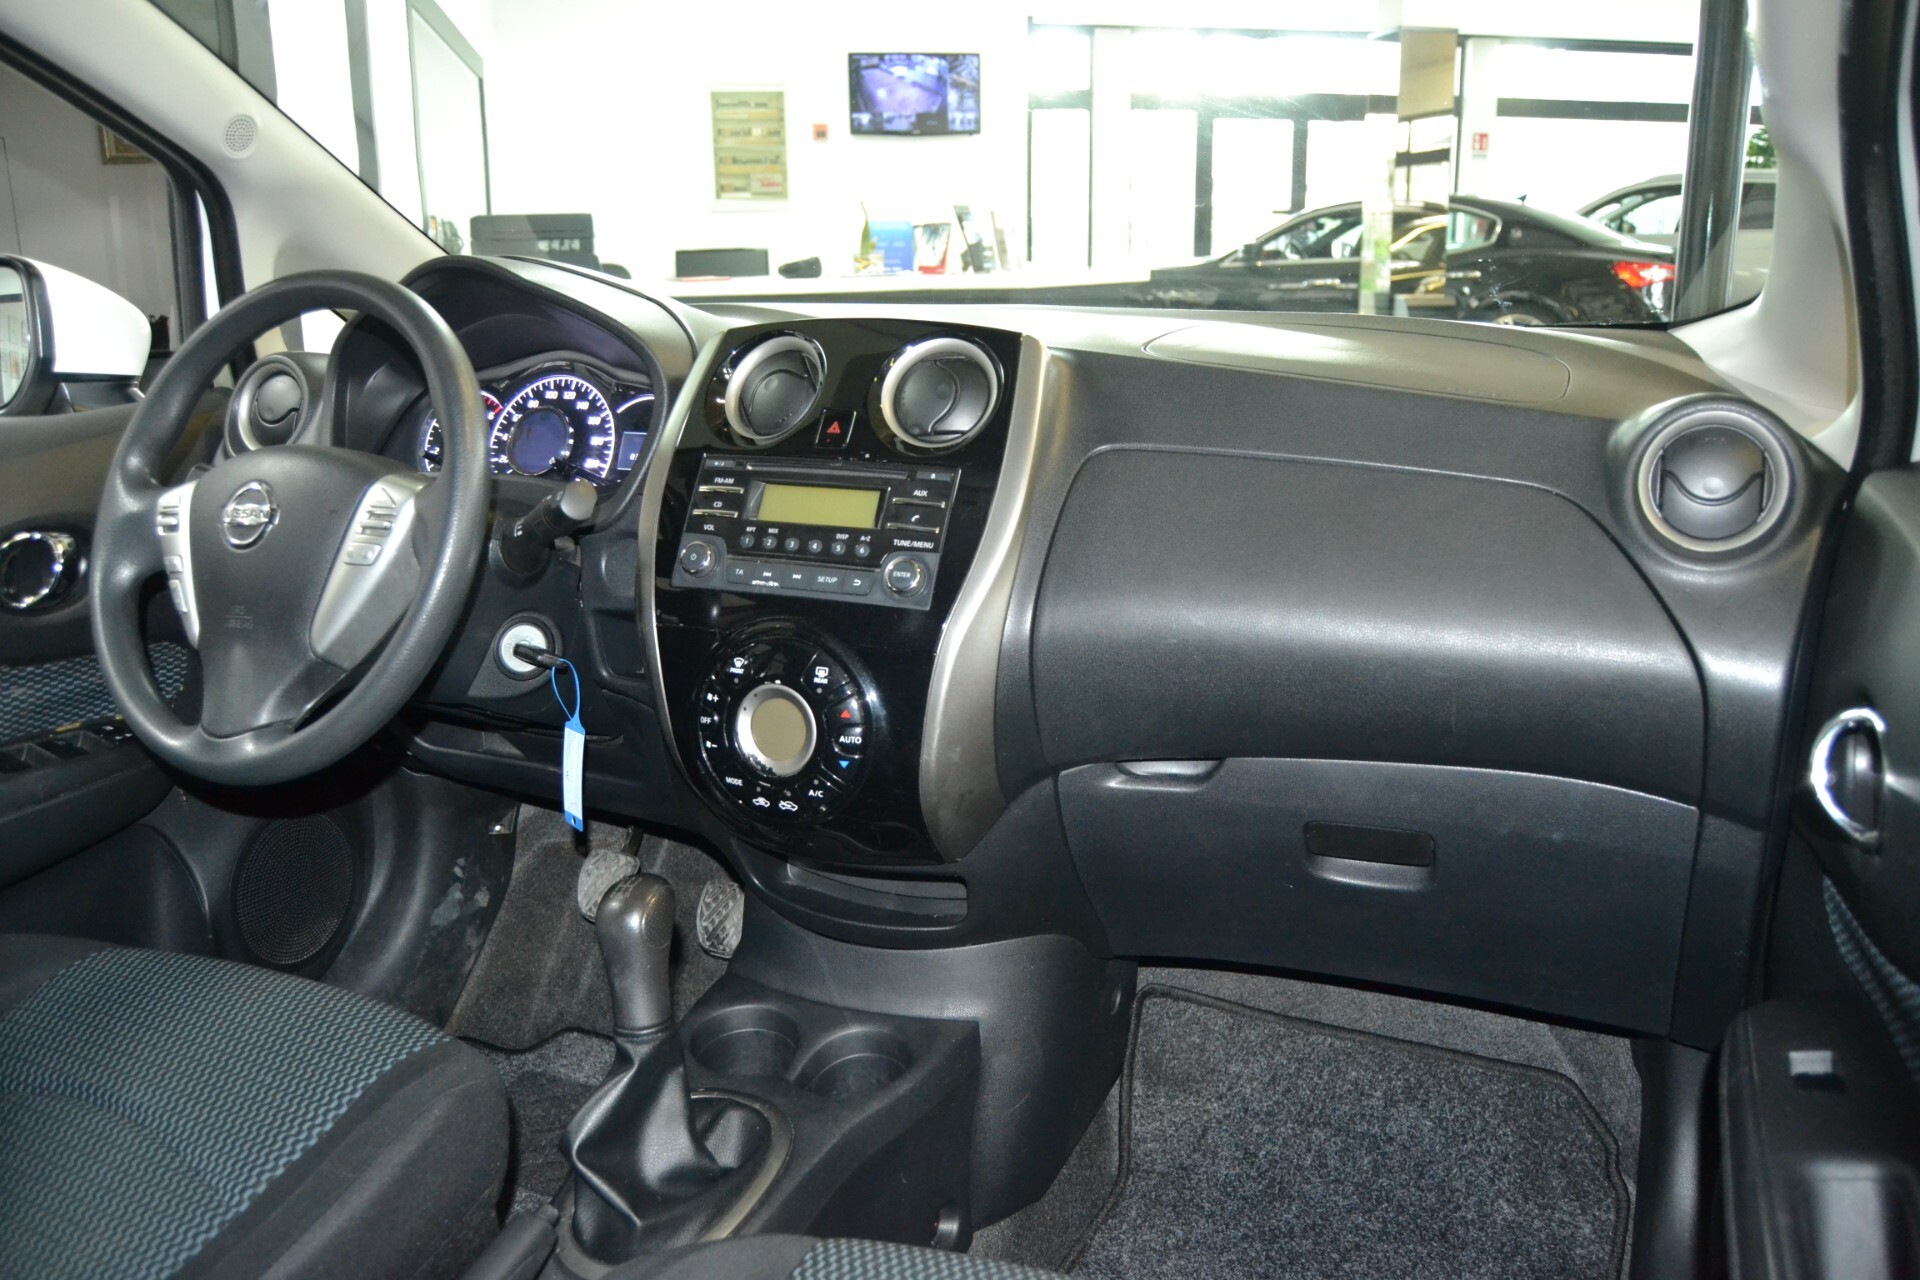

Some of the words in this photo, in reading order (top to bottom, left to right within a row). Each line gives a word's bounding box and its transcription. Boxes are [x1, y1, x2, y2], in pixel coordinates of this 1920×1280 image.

[545, 391, 558, 399] 100
[563, 391, 576, 400] 120
[527, 400, 539, 408] 80
[913, 489, 929, 497] AUX
[703, 524, 716, 532] VOL
[893, 538, 934, 550] TUNE/MENU
[893, 570, 911, 579] ENTER
[817, 575, 839, 584] SETUP
[813, 676, 829, 685] REAR
[700, 716, 712, 725] OFF
[839, 735, 862, 745] AUTO
[725, 776, 744, 787] MODE
[808, 788, 824, 798] A/C
